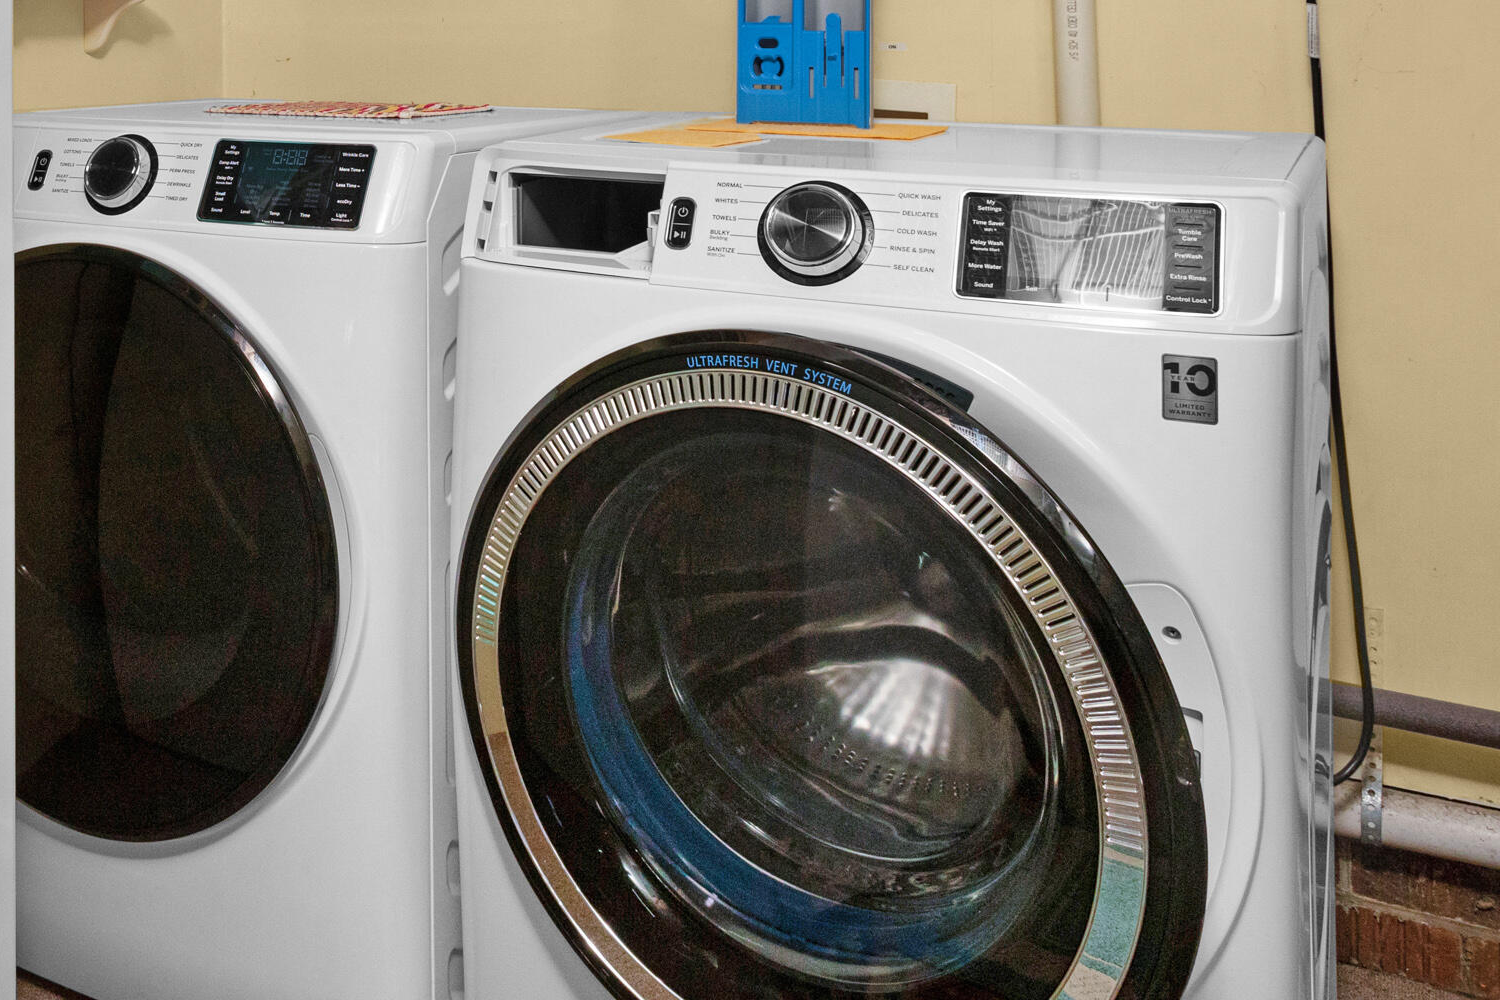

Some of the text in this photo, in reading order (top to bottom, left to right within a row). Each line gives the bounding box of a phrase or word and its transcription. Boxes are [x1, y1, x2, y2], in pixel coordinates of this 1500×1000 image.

[902, 210, 939, 218] DELICATES
[1174, 252, 1203, 260] PreWash
[1166, 295, 1190, 303] Control
[687, 354, 853, 395] ULTRAFRESH VENT SYSTEM
[1163, 362, 1216, 397] 10
[1175, 402, 1204, 410] LIMITED
[1169, 409, 1212, 417] WARRANTY
